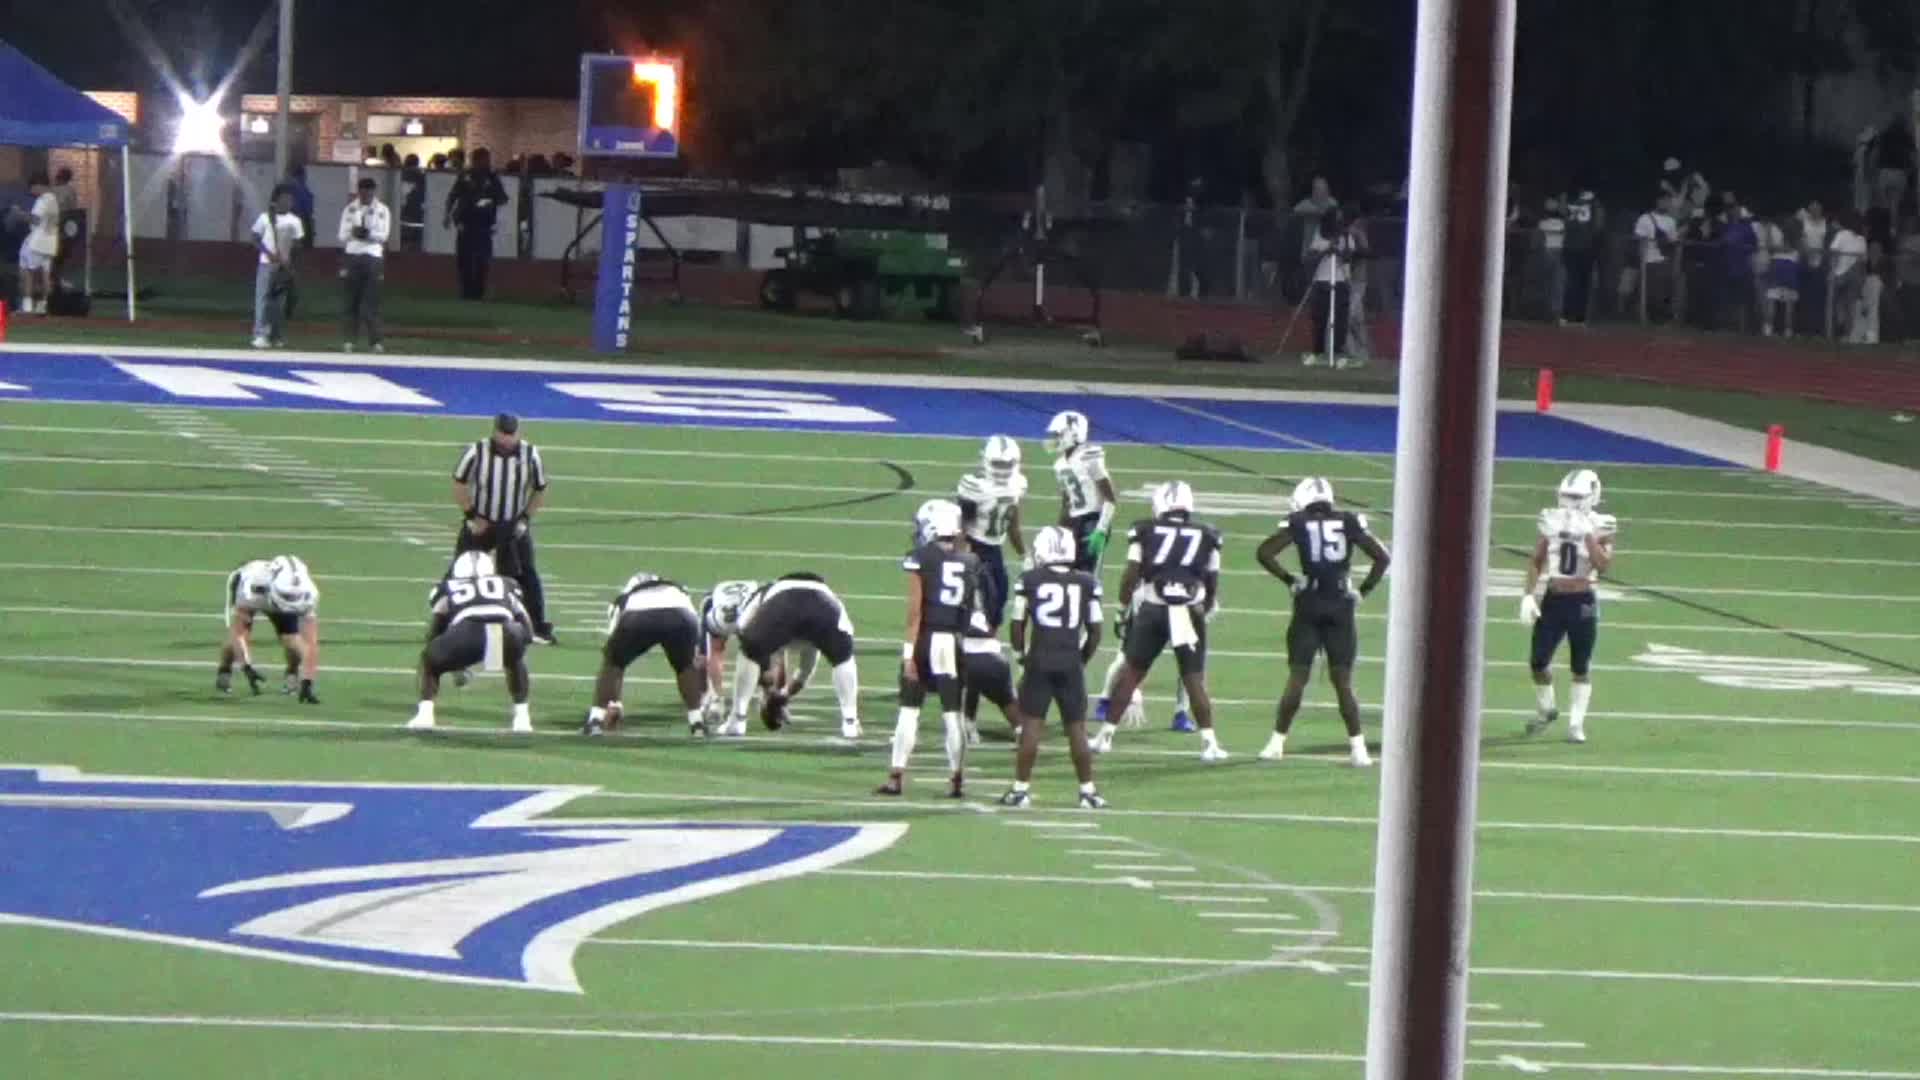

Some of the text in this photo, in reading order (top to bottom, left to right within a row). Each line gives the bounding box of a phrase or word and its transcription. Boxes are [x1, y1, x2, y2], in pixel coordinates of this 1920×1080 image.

[633, 62, 677, 131] 7
[615, 213, 639, 348] SPARTANS
[1152, 525, 1203, 567] 77
[1304, 519, 1347, 563] 15
[1559, 541, 1578, 577] 0
[448, 576, 504, 602] 50
[939, 561, 965, 606] 5
[1036, 583, 1081, 629] 21
